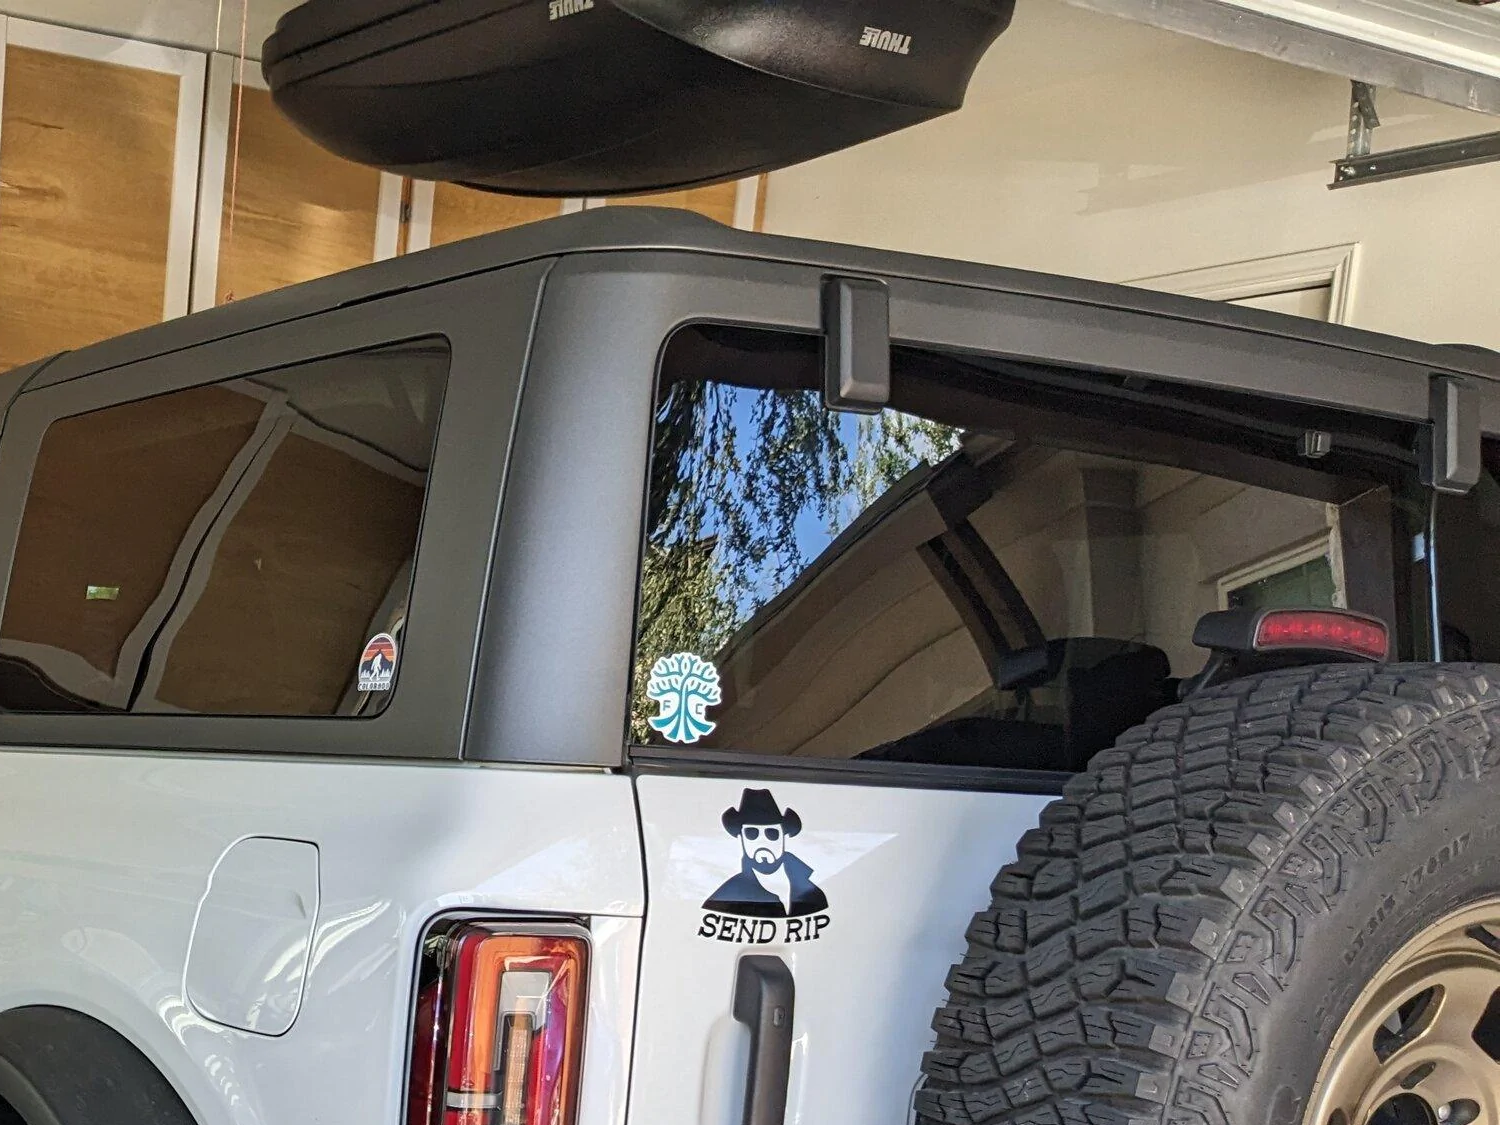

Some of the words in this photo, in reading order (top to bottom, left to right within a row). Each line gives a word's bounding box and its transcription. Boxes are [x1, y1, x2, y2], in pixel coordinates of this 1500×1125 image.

[859, 26, 912, 55] THULE
[359, 682, 390, 691] COLORADO
[697, 912, 778, 944] SEND
[784, 914, 831, 944] RIP
